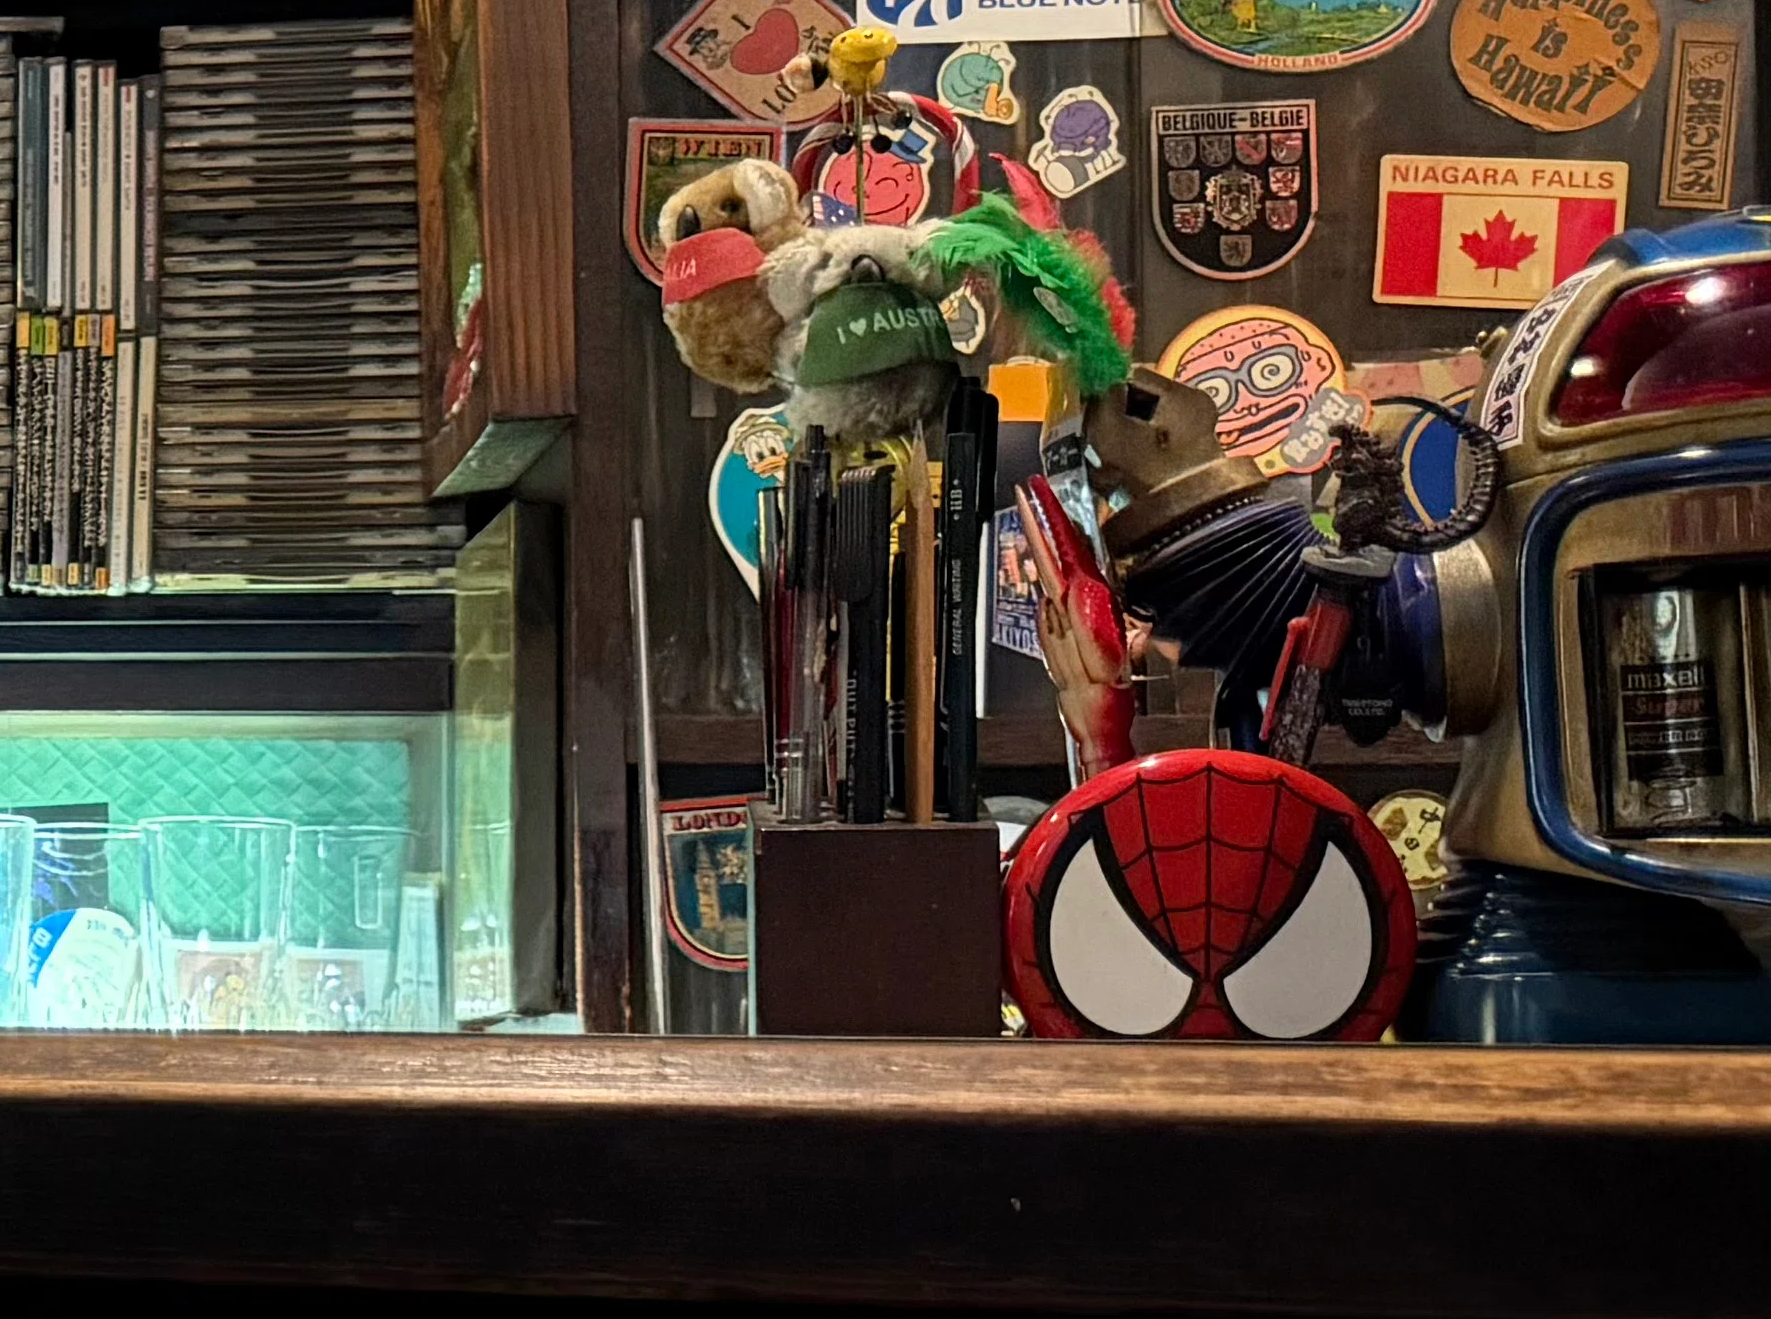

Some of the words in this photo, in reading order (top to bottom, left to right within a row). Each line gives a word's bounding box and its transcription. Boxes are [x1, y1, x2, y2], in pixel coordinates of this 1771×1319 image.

[1532, 18, 1568, 60] is
[1257, 52, 1339, 69] HOLLAND
[1391, 163, 1519, 188] NIAGARA
[1532, 168, 1615, 191] FALLS
